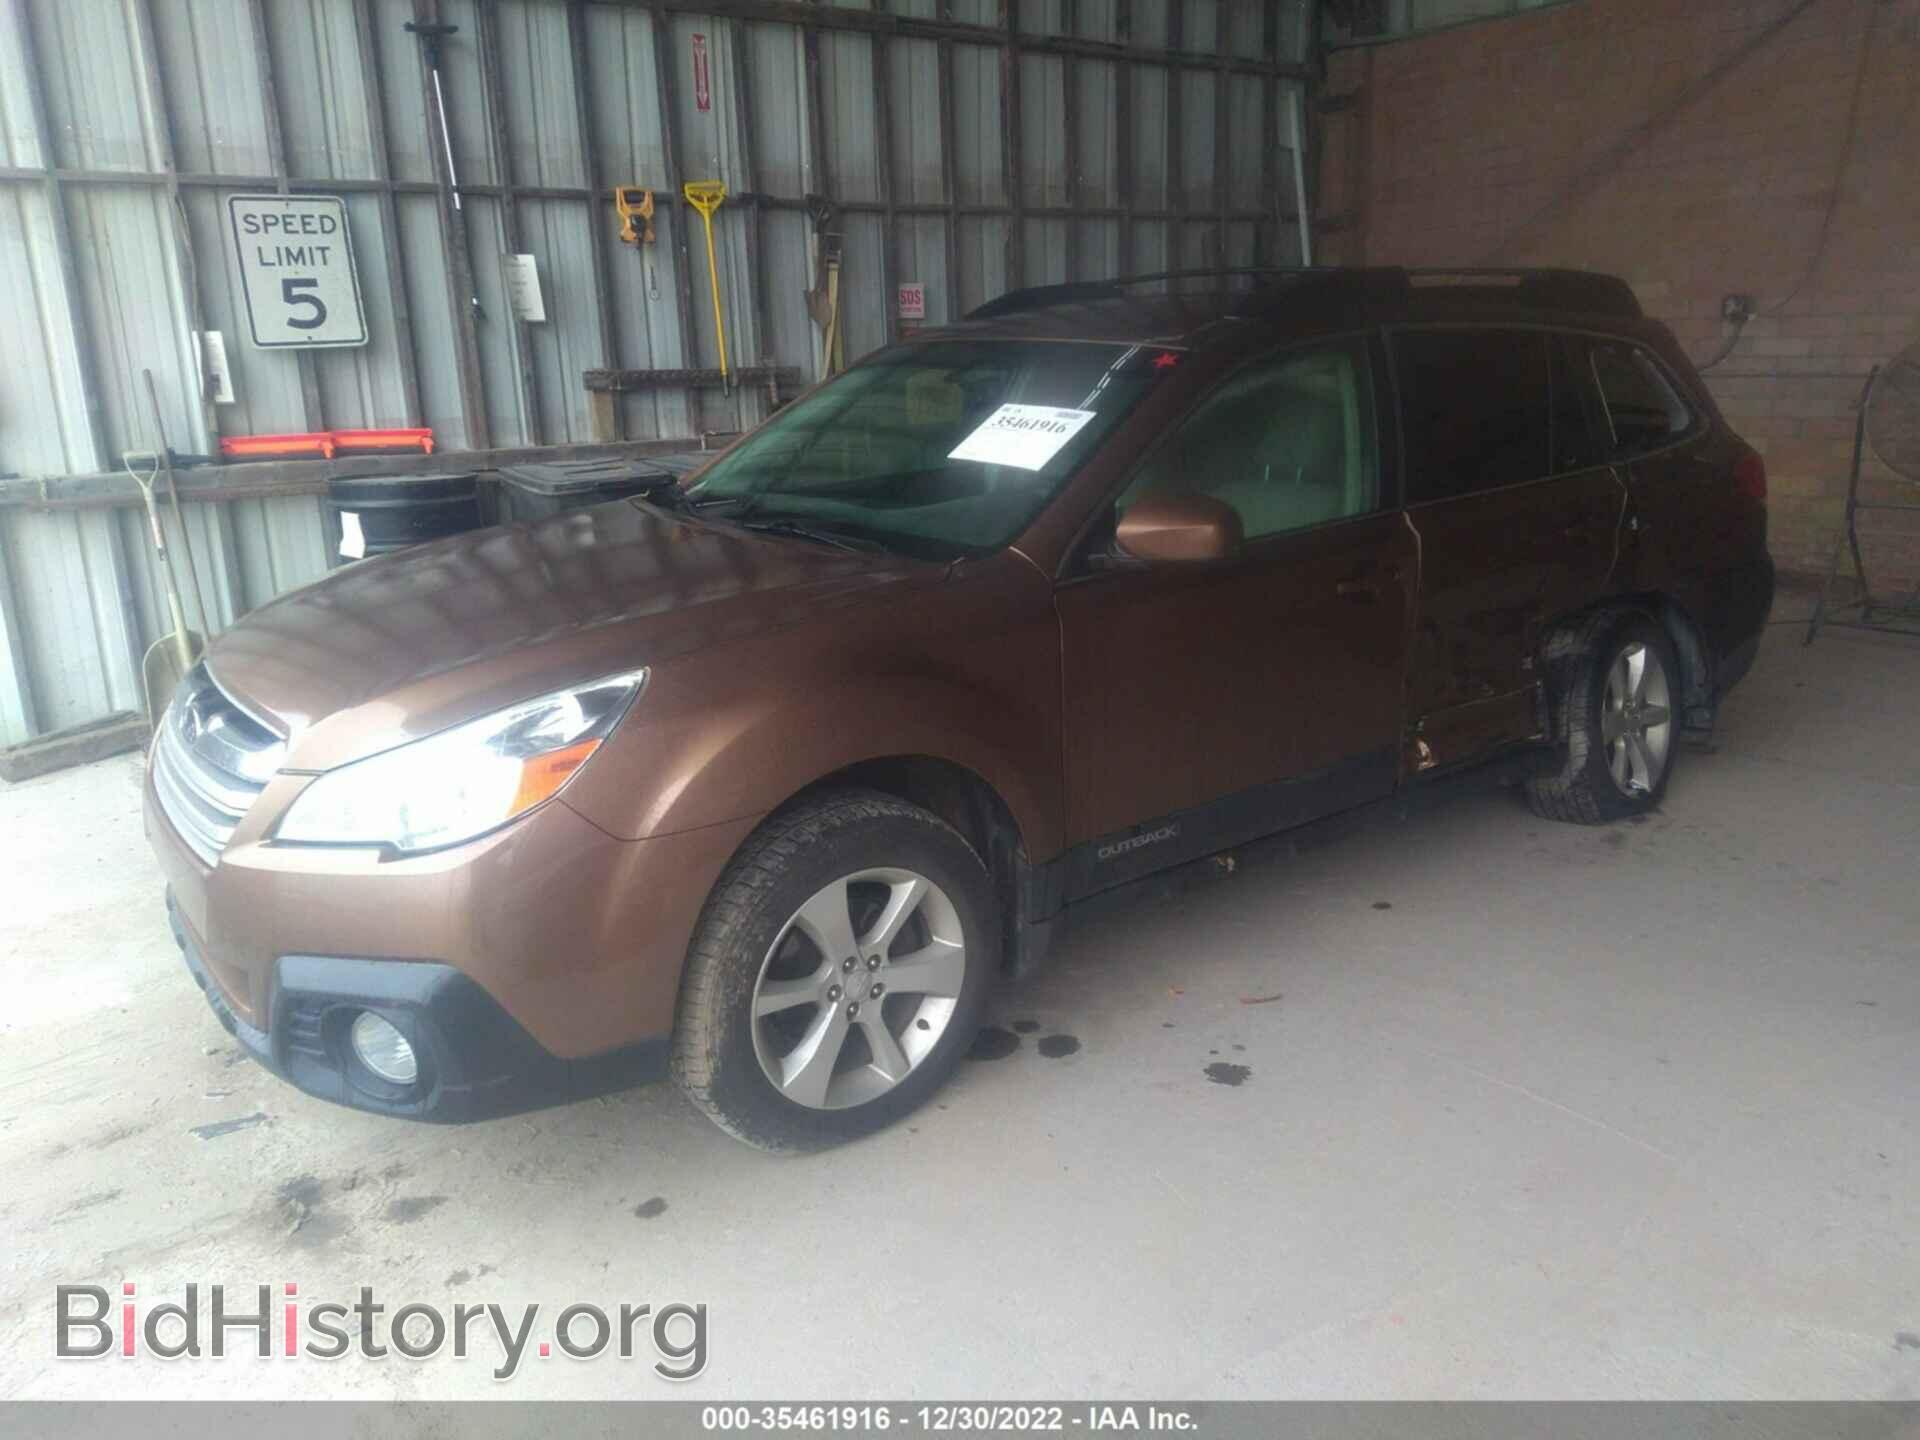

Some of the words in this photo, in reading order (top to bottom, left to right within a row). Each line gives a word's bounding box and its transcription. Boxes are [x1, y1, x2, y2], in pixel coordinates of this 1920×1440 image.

[242, 213, 337, 235] SPEED
[257, 245, 331, 267] LIMIT
[281, 277, 328, 330] 5
[900, 289, 921, 305] SDS
[991, 416, 1067, 433] 35461916
[1098, 825, 1177, 858] OUTBACK
